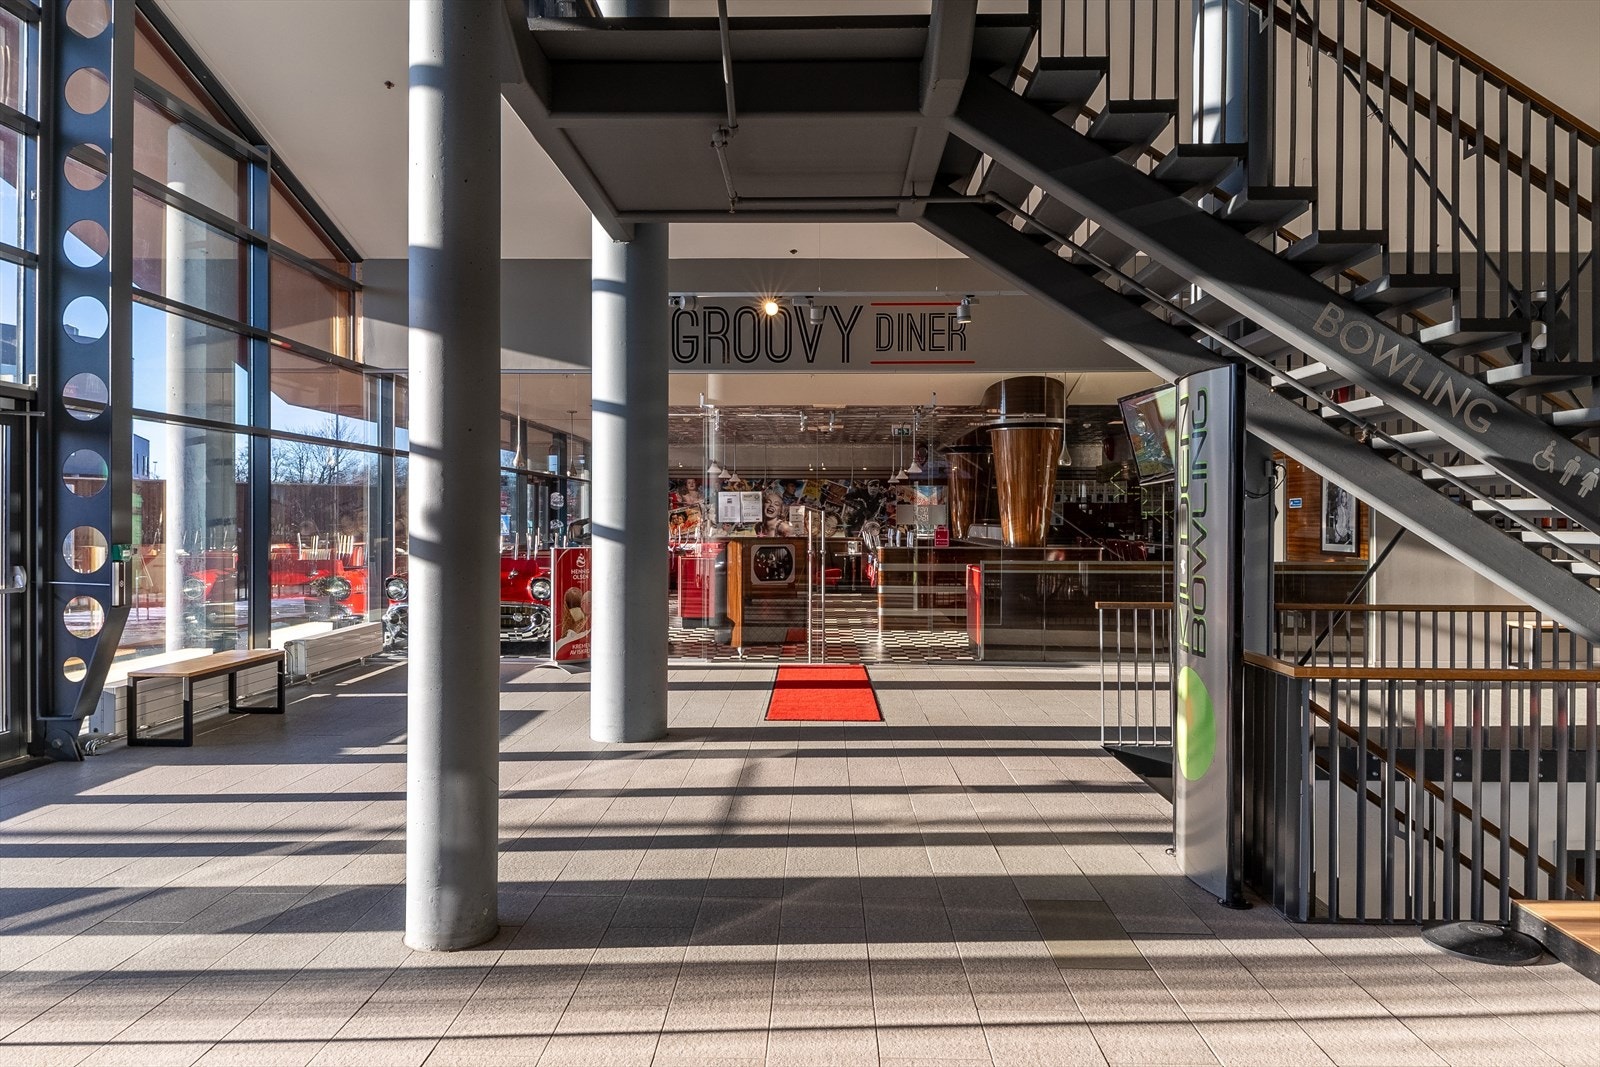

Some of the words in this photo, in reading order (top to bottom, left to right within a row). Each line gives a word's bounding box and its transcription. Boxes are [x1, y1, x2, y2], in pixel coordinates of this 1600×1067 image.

[671, 305, 863, 364] GROOVY
[875, 312, 968, 352] DINER
[1312, 301, 1498, 434] BOWLING
[1179, 393, 1190, 654] KILDEN
[1191, 387, 1207, 658] BOWLING
